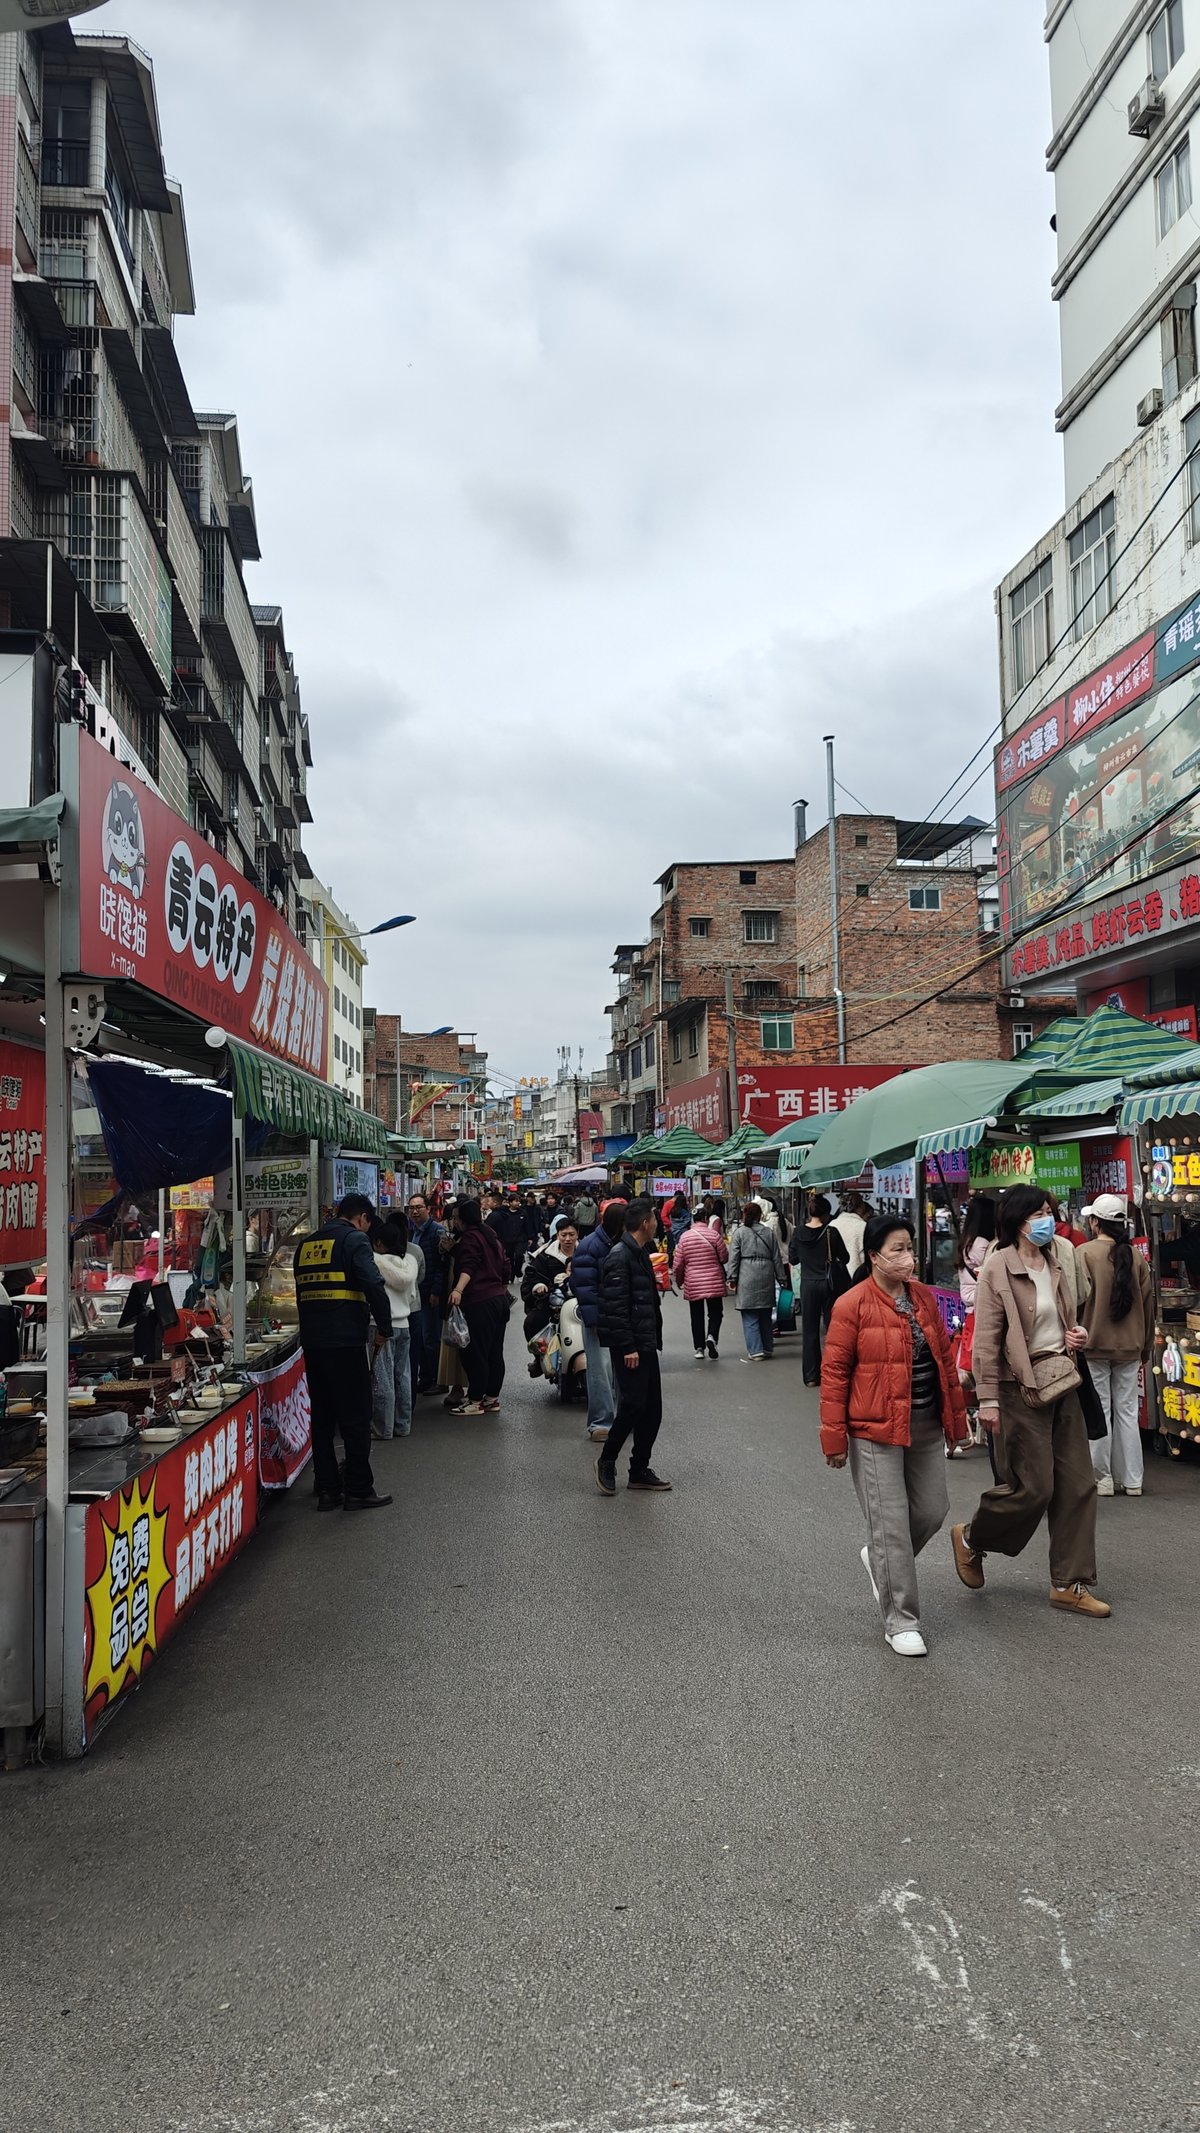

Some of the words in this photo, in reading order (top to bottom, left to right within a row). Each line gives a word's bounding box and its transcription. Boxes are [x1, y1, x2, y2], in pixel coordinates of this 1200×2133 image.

[1017, 717, 1059, 768] 木薯羹
[997, 815, 1010, 878] 入口
[100, 883, 147, 958] 晓馋猫
[169, 856, 255, 977] 青云特产
[163, 960, 190, 999] QING
[1172, 1152, 1200, 1186] 五色
[0, 1182, 38, 1231] 肉脯
[110, 1516, 150, 1597] 免费
[176, 1480, 242, 1614] 品质不打折
[110, 1579, 150, 1671] 品尝
